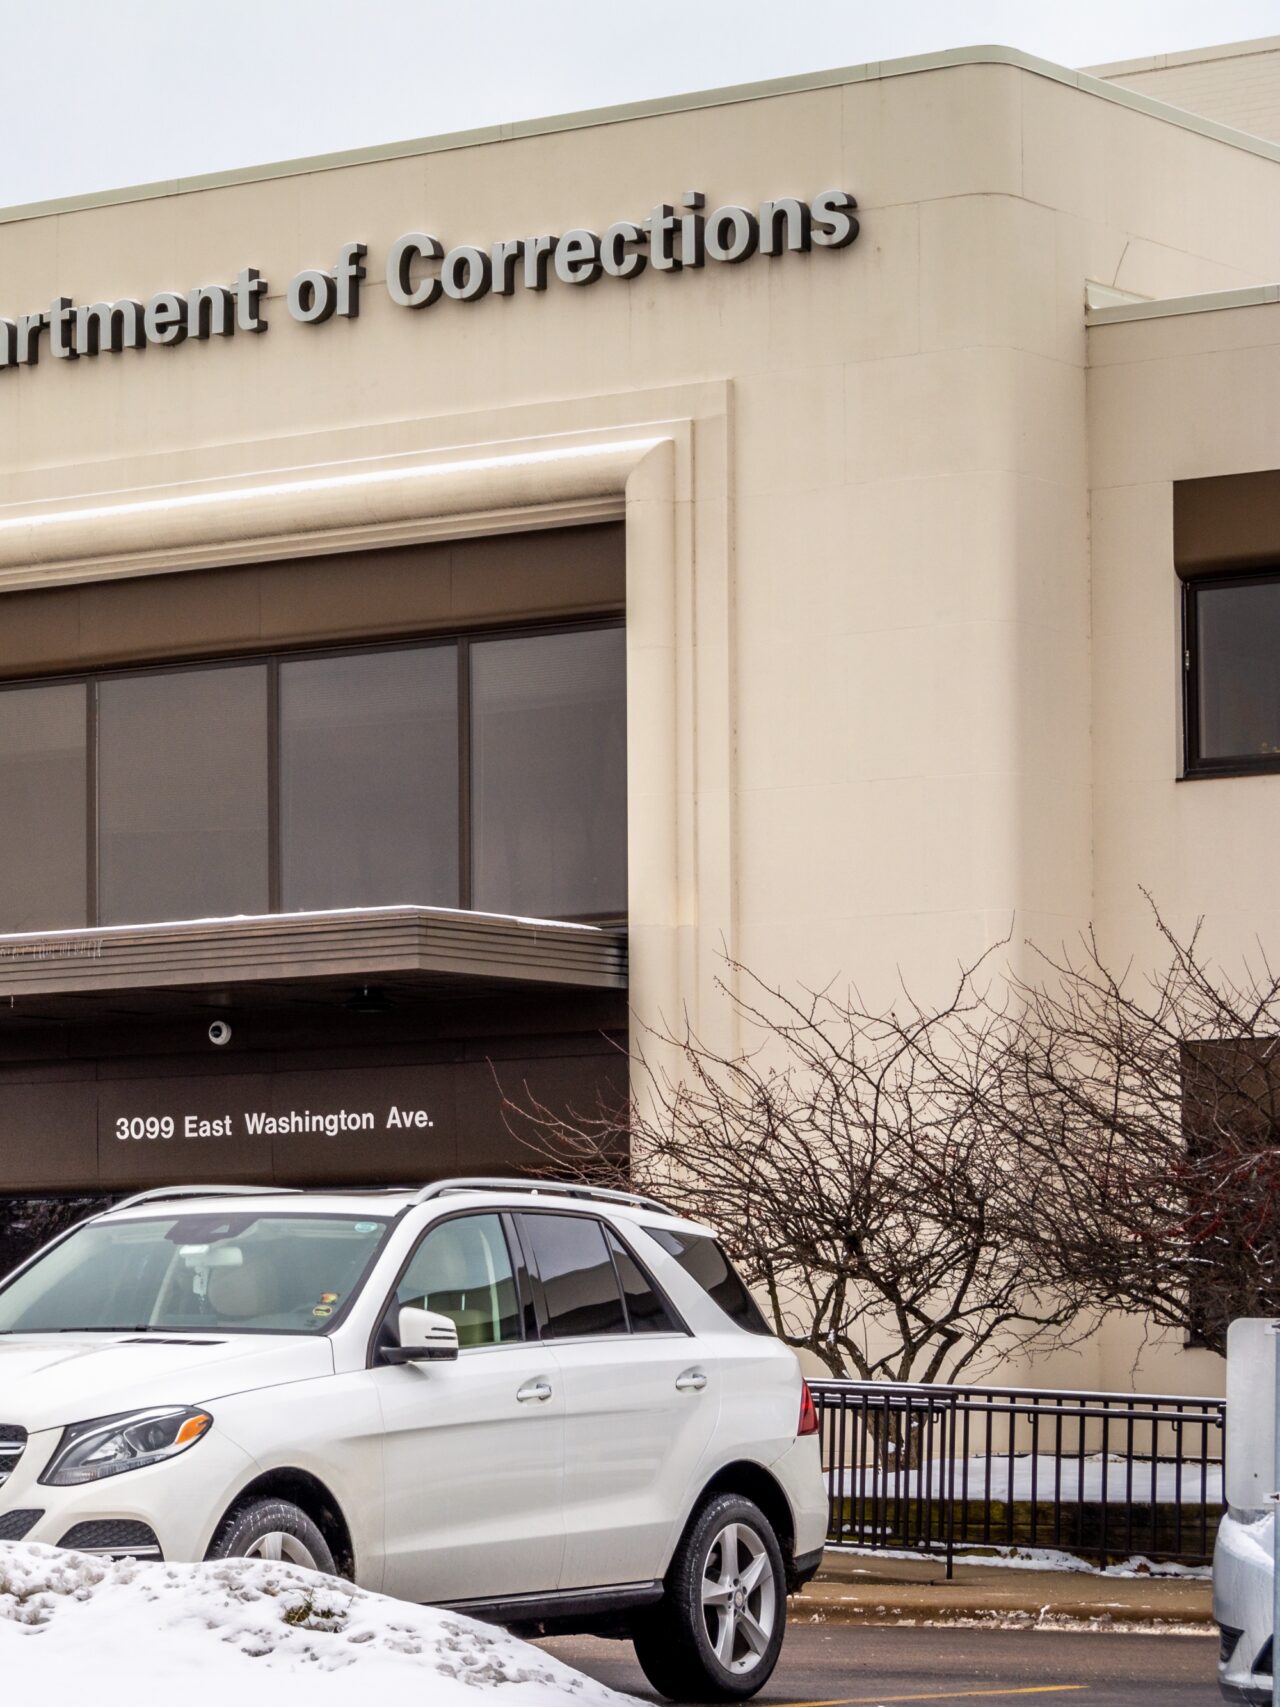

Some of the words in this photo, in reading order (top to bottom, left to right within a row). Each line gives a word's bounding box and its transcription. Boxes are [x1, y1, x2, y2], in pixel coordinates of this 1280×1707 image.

[286, 243, 367, 325] of
[386, 189, 858, 309] Corrections
[116, 1117, 175, 1140] 3099
[184, 1115, 232, 1138] East
[244, 1109, 375, 1137] Washington
[386, 1105, 435, 1128] Ave.
